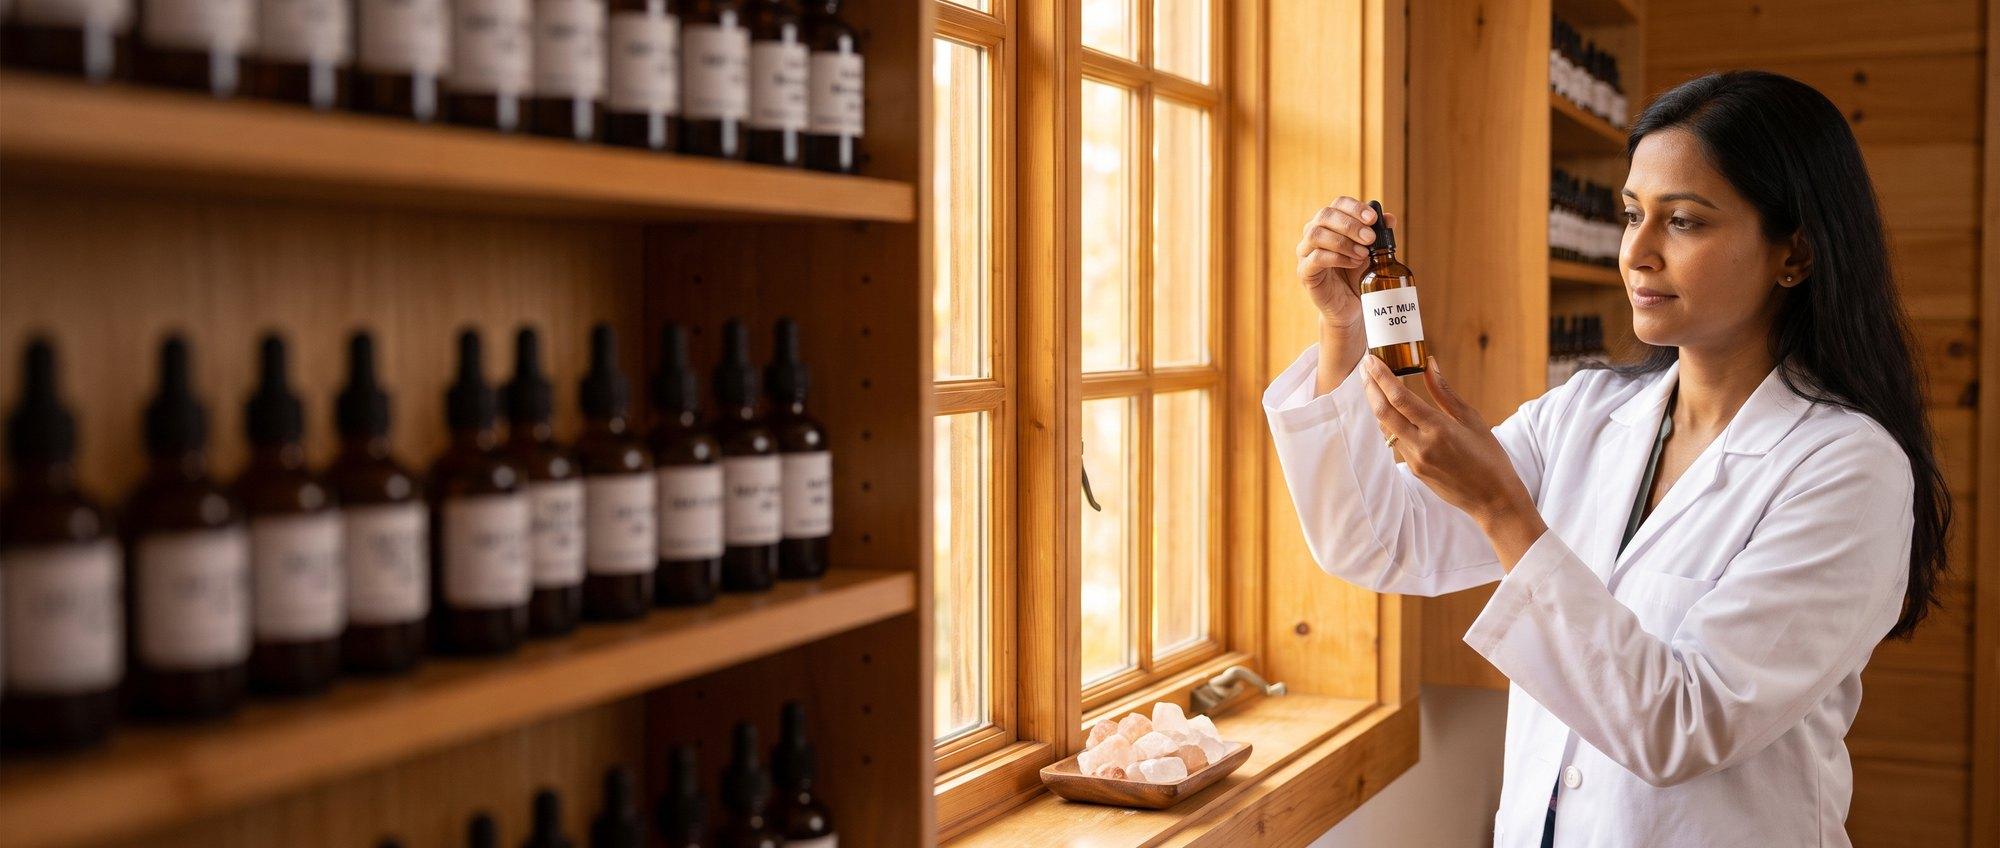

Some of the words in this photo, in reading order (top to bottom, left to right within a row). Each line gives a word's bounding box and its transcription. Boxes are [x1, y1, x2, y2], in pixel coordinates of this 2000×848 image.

[1374, 306, 1393, 316] NAT
[1396, 302, 1416, 312] MUR
[1388, 316, 1407, 326] 30C
